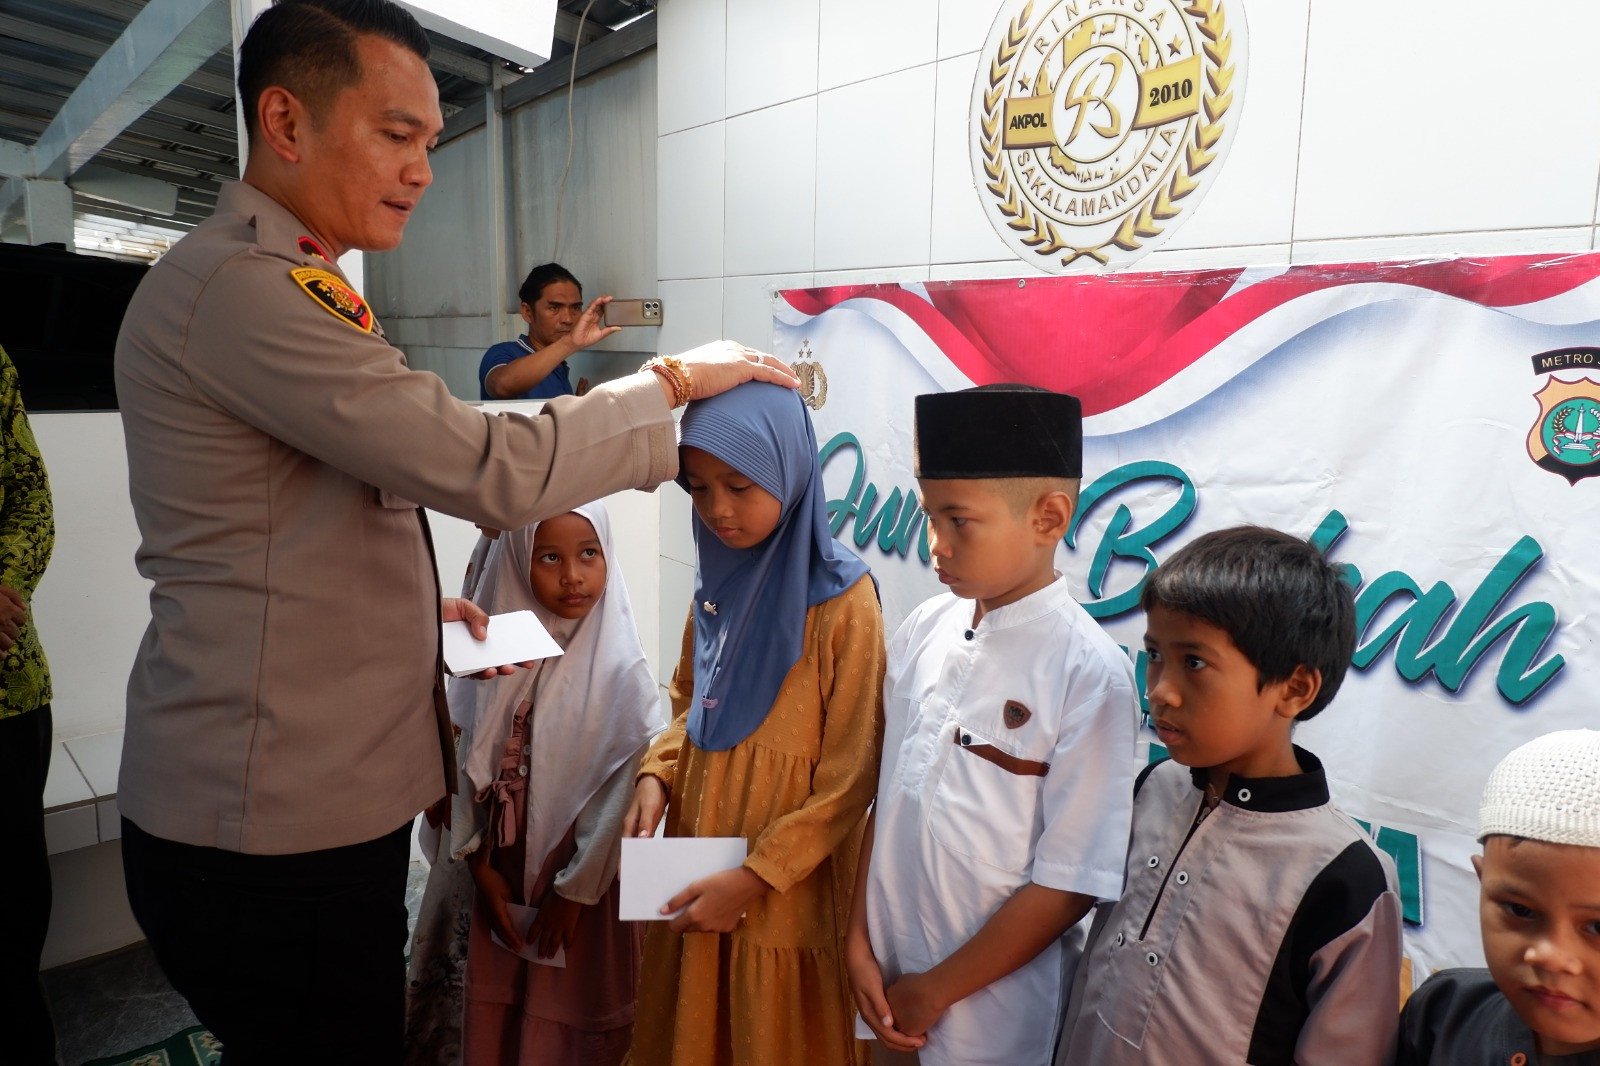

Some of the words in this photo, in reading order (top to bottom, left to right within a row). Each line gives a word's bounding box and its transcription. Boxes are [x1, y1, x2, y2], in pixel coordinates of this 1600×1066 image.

[1149, 78, 1193, 107] 2010
[1009, 112, 1047, 130] AKPOL
[1017, 128, 1177, 217] SAKALAMANDALA
[1541, 353, 1593, 368] METRO
